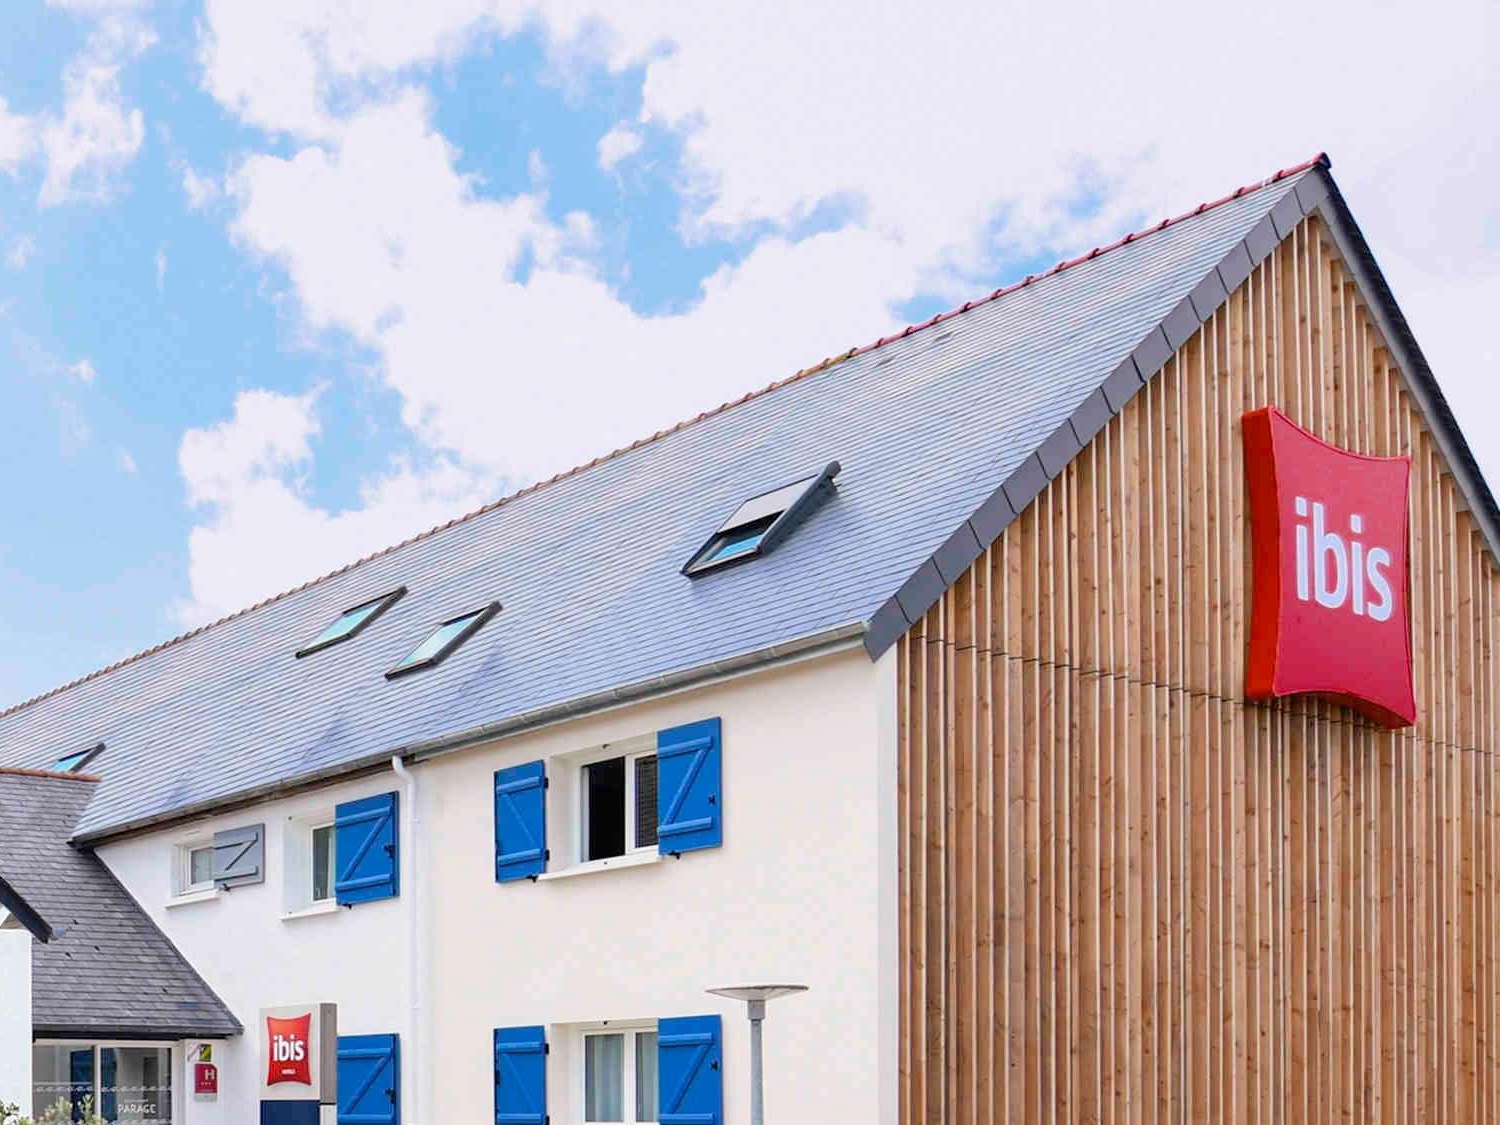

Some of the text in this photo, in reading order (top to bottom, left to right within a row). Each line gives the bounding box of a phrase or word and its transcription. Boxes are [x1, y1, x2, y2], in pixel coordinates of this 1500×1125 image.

[1295, 496, 1393, 622] ibis
[273, 1034, 304, 1061] ibis
[204, 1069, 215, 1080] H
